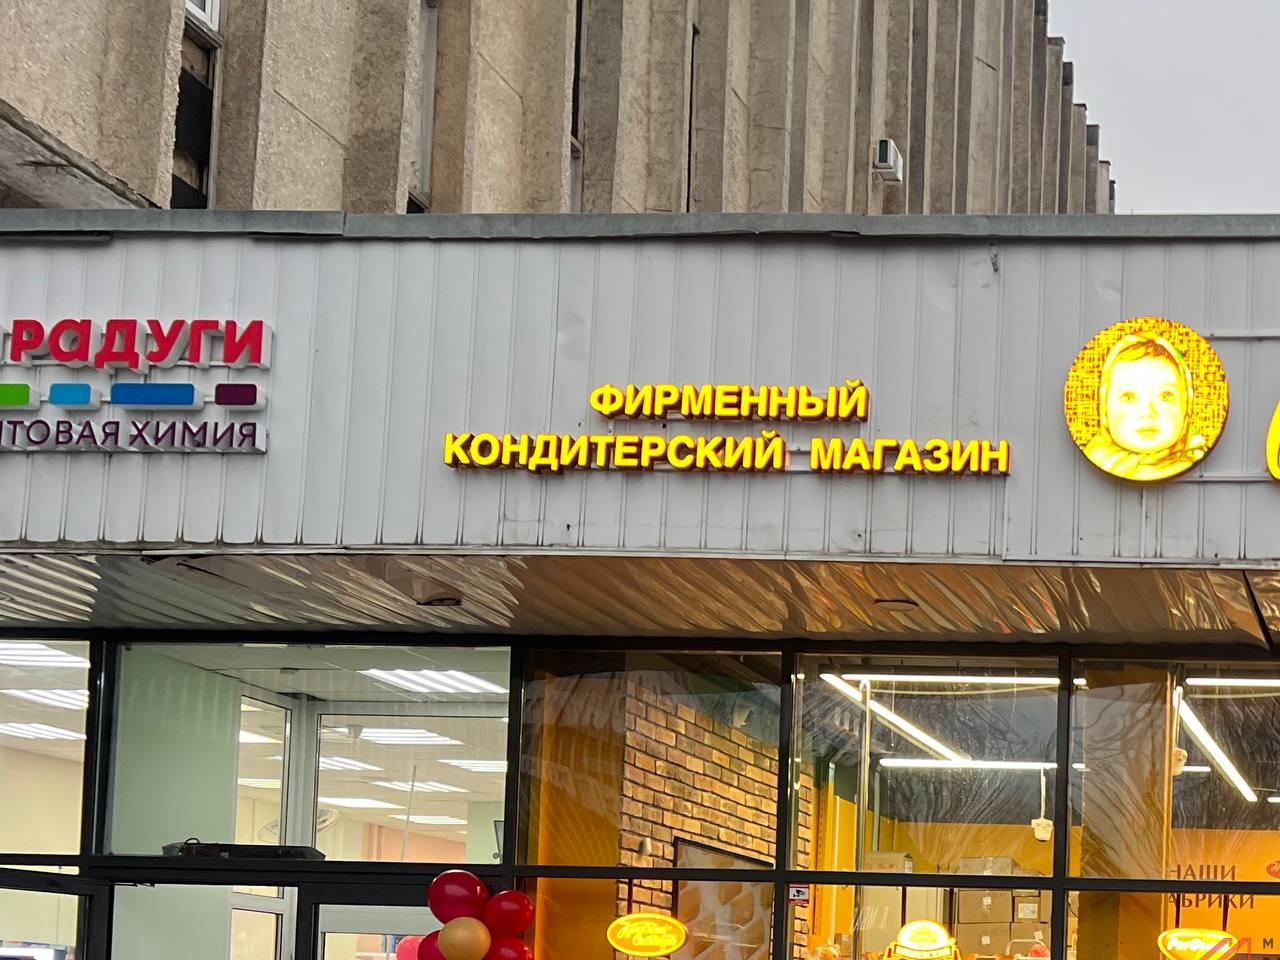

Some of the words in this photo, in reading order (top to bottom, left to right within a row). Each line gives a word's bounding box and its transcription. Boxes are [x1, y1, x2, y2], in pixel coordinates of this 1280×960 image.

[589, 378, 869, 420] ФИРМЕННЫЙ
[0, 419, 120, 446] ТОВАЯ
[129, 421, 258, 448] ХИМИЯ
[443, 430, 785, 472] КОНДИТЕРСКИЙ
[809, 437, 1010, 474] МАГАЗИН
